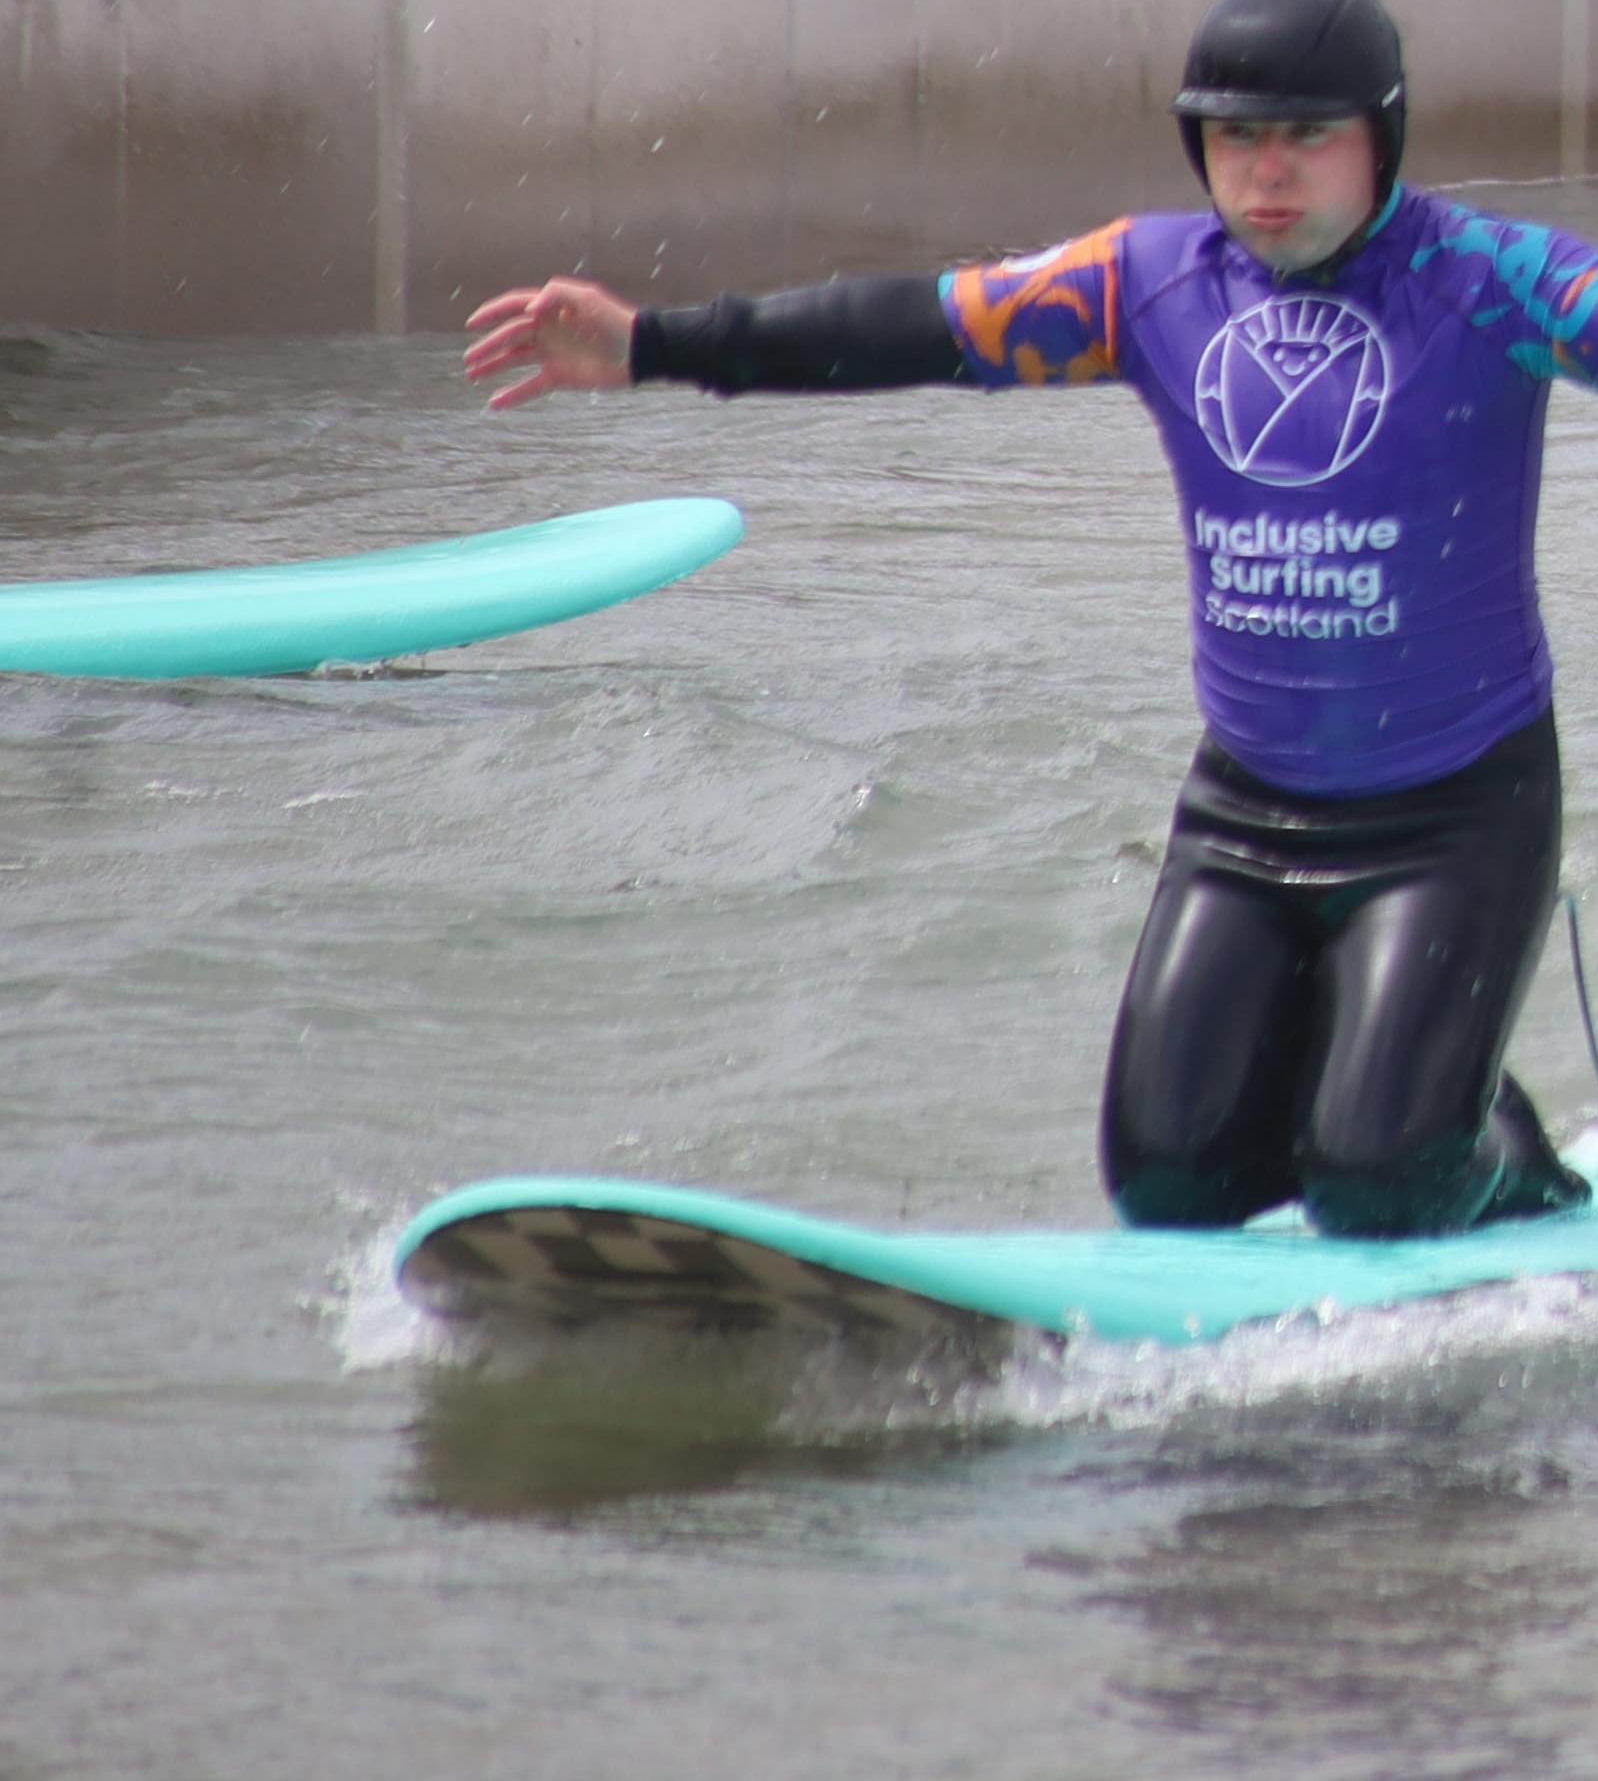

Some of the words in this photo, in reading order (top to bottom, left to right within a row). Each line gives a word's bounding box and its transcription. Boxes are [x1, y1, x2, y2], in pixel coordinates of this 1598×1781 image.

[1194, 506, 1400, 555] Inclusive
[1209, 554, 1383, 608] Surfing
[1204, 592, 1398, 639] Scotland
